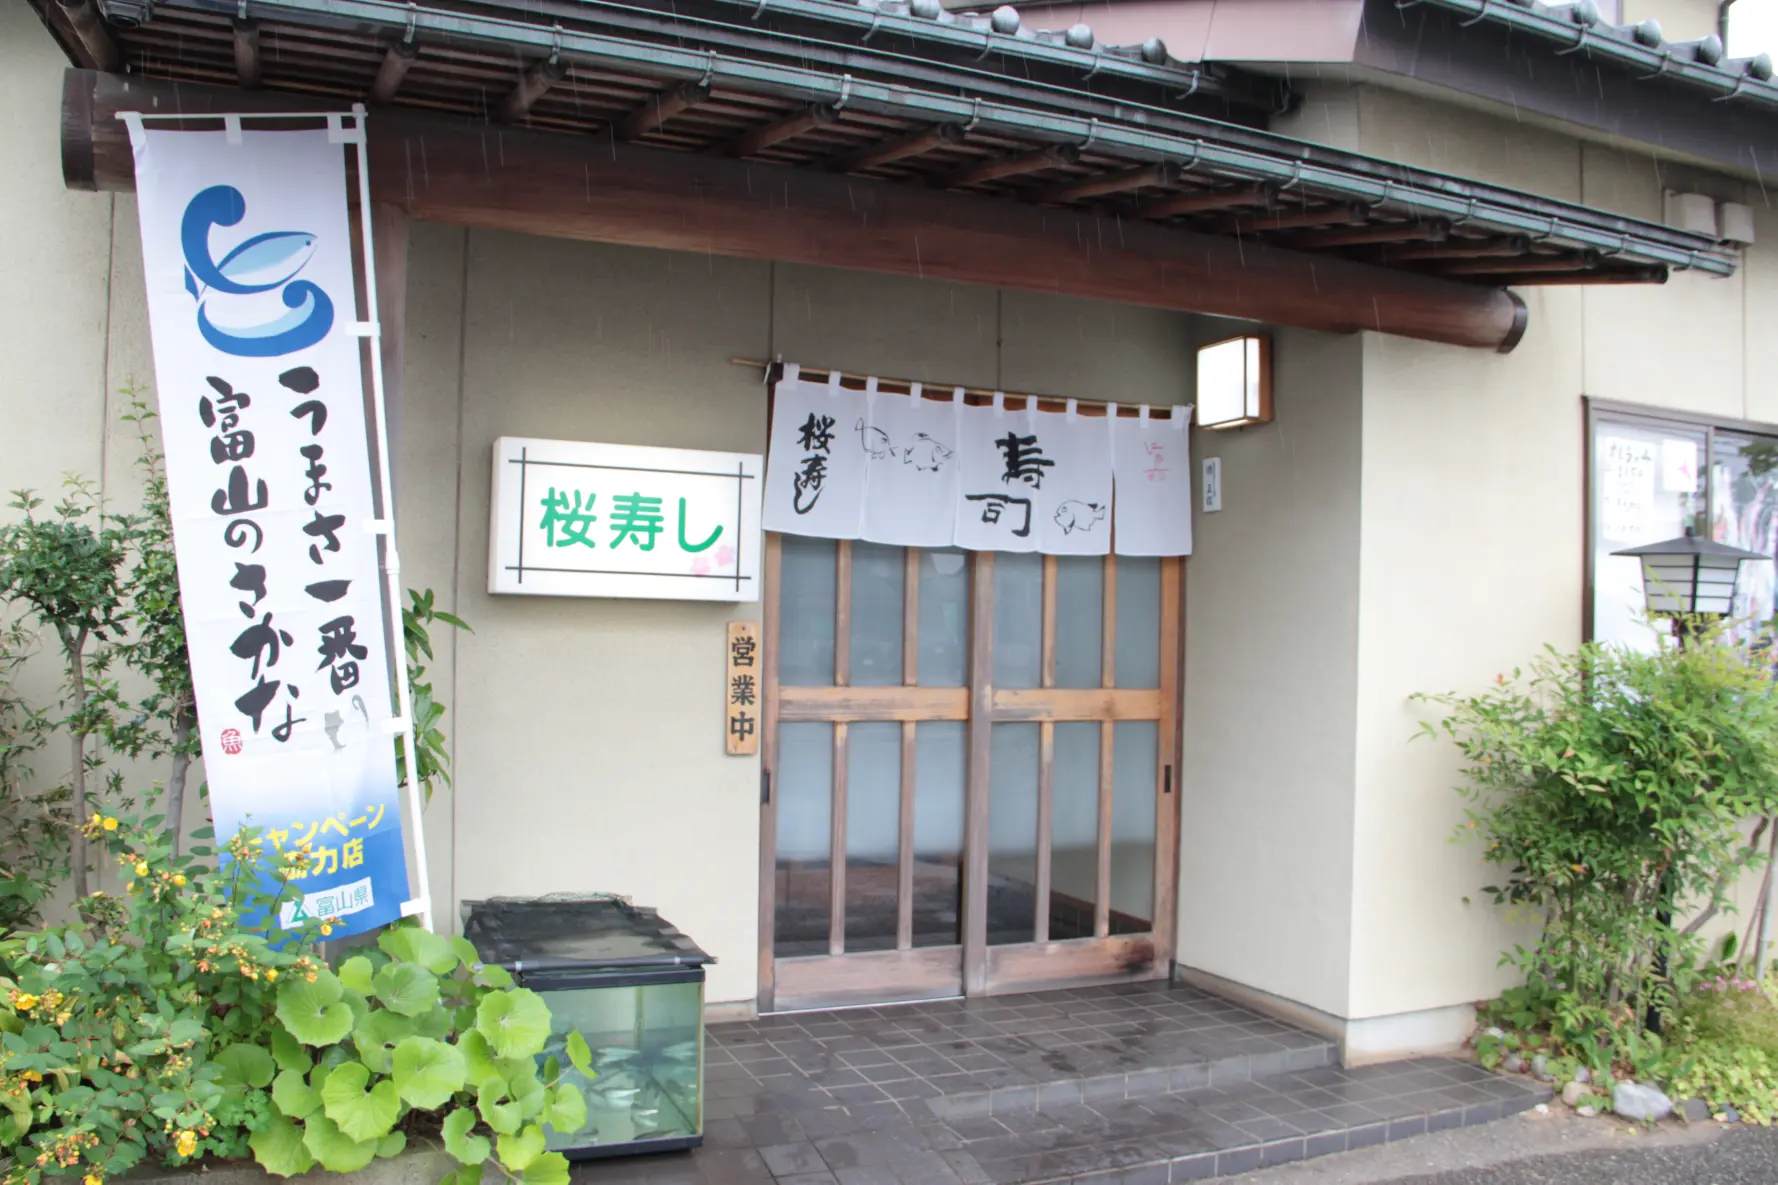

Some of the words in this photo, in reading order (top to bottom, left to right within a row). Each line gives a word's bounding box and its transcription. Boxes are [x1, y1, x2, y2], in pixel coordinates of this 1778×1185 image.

[793, 412, 836, 514] 桜寿し
[199, 375, 306, 743] 富山のさかな
[278, 366, 368, 696] うまさ一番
[540, 486, 723, 553] 桜寿し
[730, 635, 756, 742] 営業中
[248, 803, 385, 849] ャンペーン
[316, 886, 369, 917] 富山県
